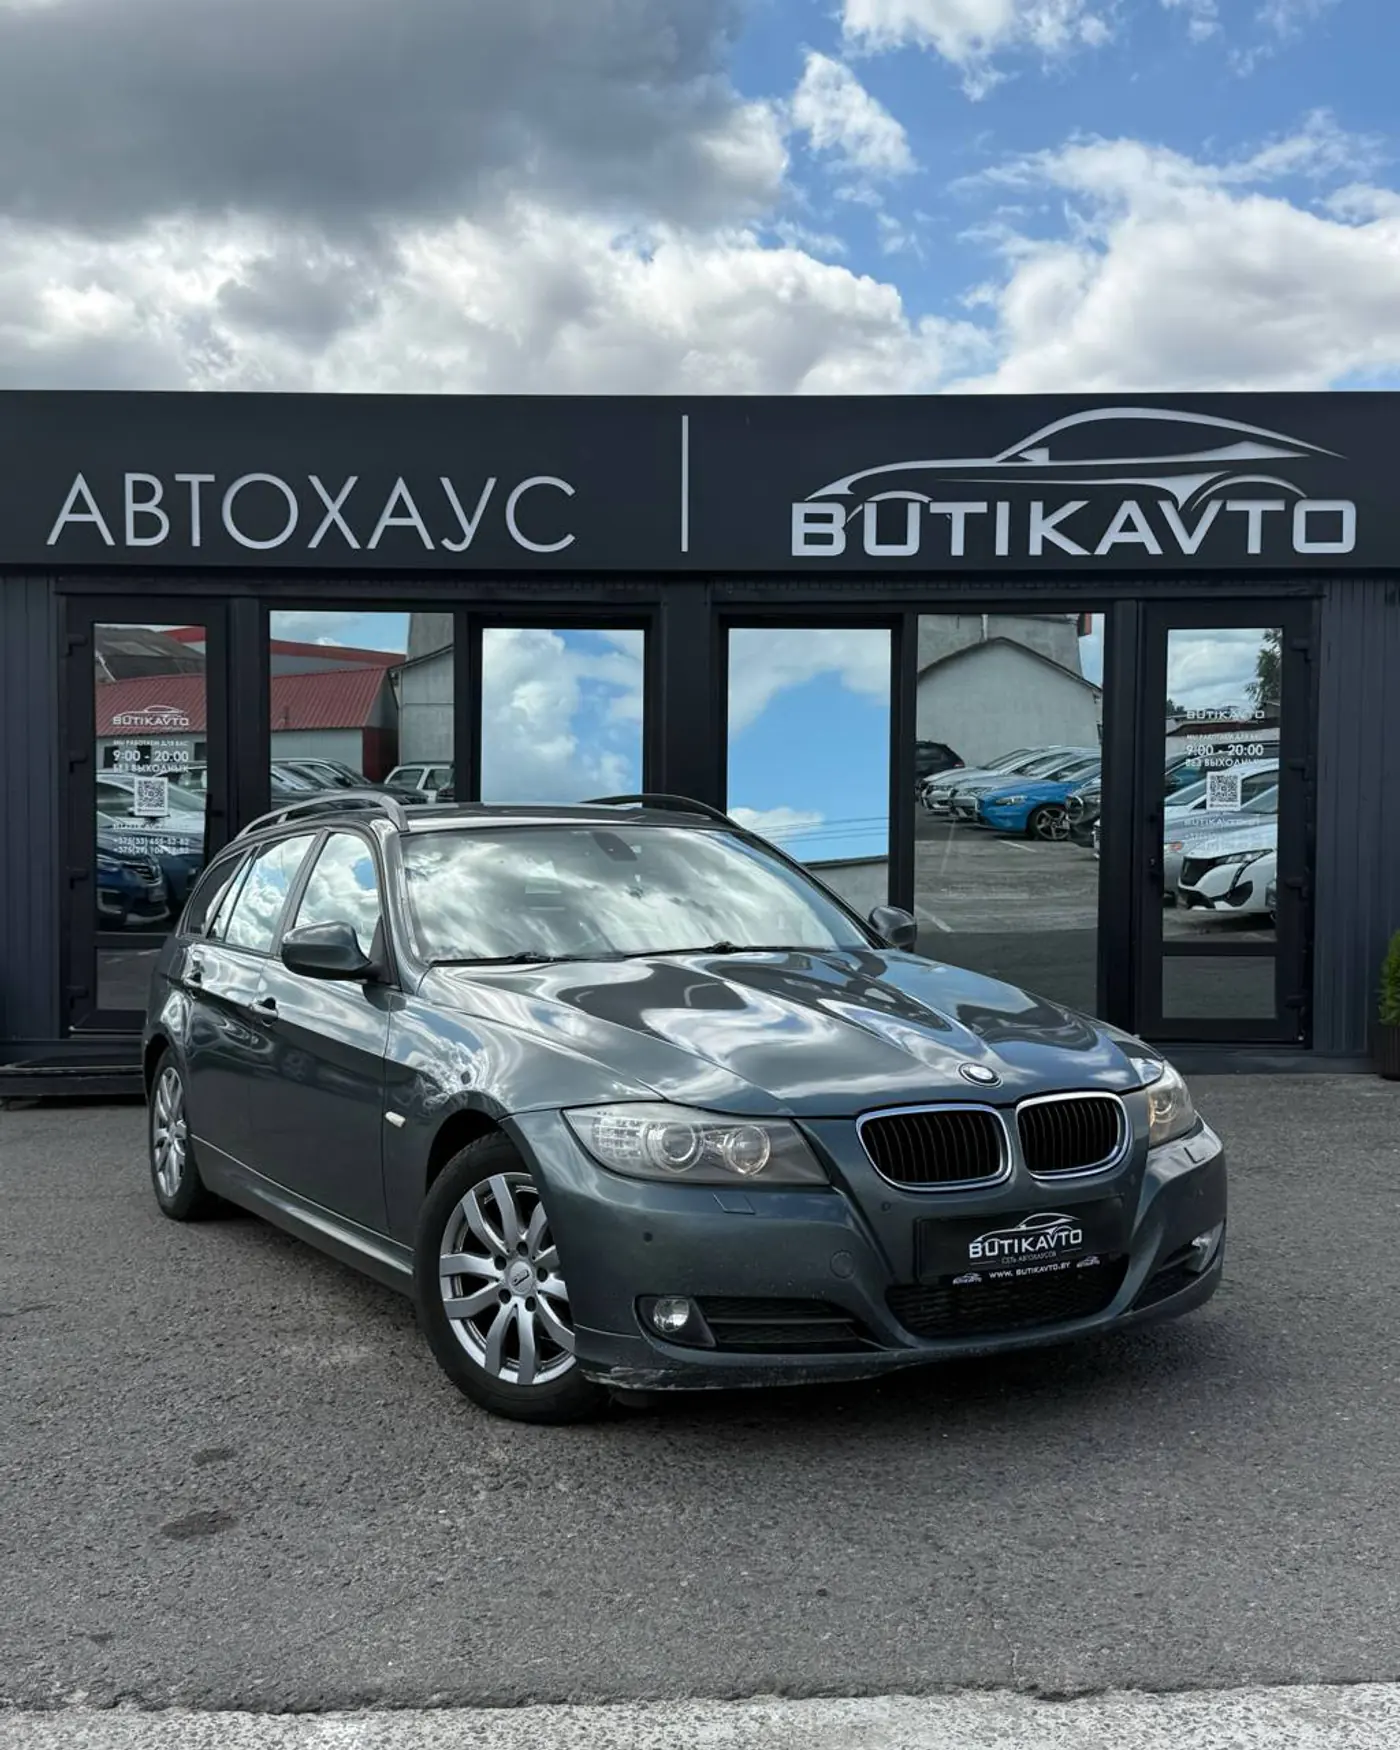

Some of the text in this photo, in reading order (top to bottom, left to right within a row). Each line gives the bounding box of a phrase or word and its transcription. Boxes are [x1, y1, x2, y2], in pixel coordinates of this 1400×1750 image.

[47, 472, 576, 552] АВТОХАУС
[791, 500, 1356, 556] BUTIKAVTO
[112, 716, 189, 726] BUTIKAVTO
[1186, 709, 1265, 720] BUTIKAVTO
[112, 750, 141, 761] 9:00
[154, 750, 189, 762] 20:00
[1186, 744, 1214, 756] 9:00
[1227, 743, 1264, 756] 20:00
[969, 1229, 1083, 1259] BUTIKAVTO
[988, 1269, 1013, 1279] WWW.
[1015, 1261, 1071, 1277] BUTIKAVTO.BY
